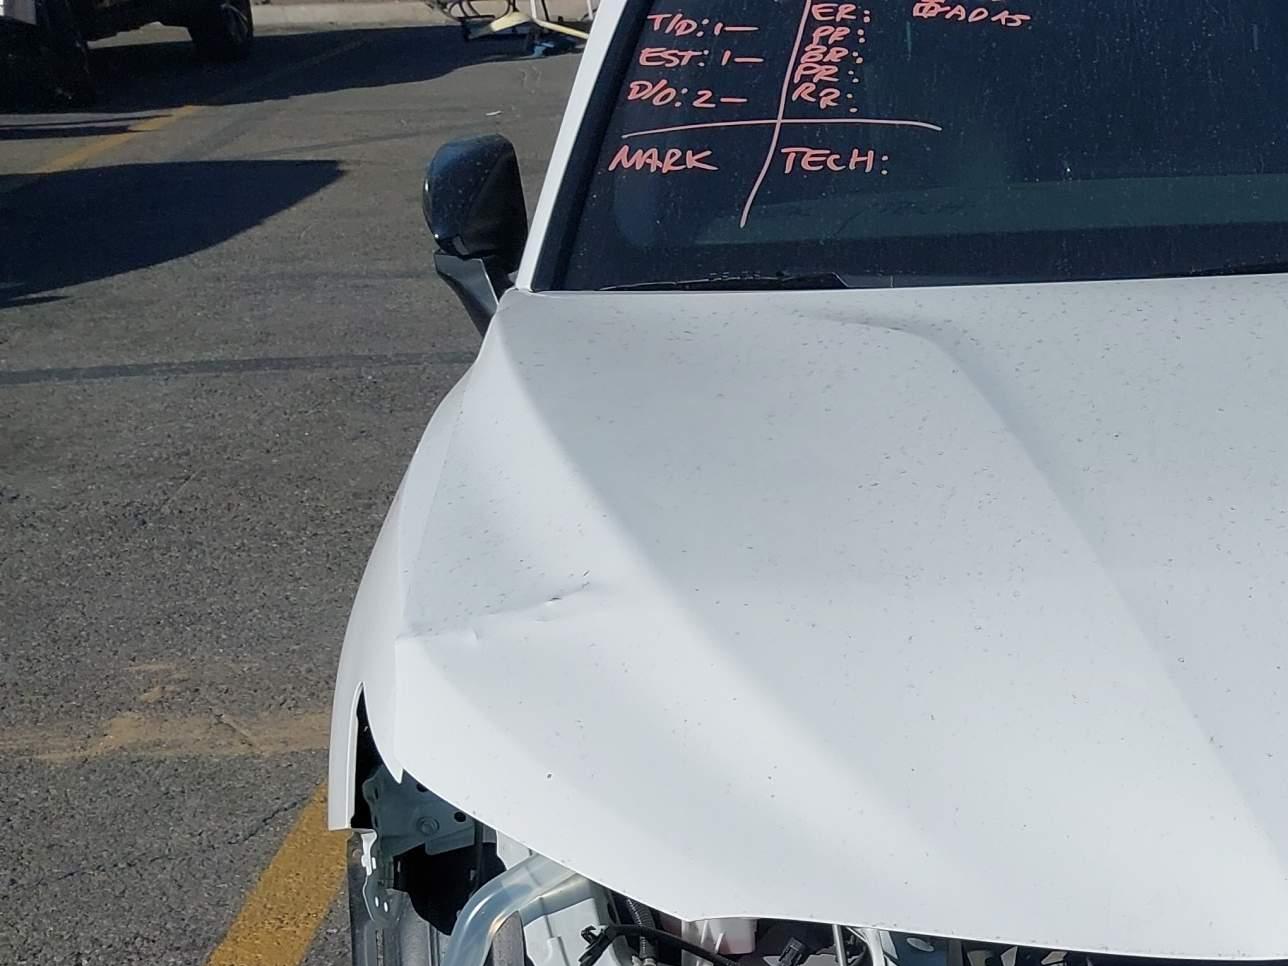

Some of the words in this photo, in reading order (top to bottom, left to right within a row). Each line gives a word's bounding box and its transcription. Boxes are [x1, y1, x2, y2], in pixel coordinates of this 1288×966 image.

[647, 13, 710, 38] T/D:
[638, 47, 710, 68] EST:
[608, 144, 720, 173] MARK
[780, 146, 890, 175] TECH:
